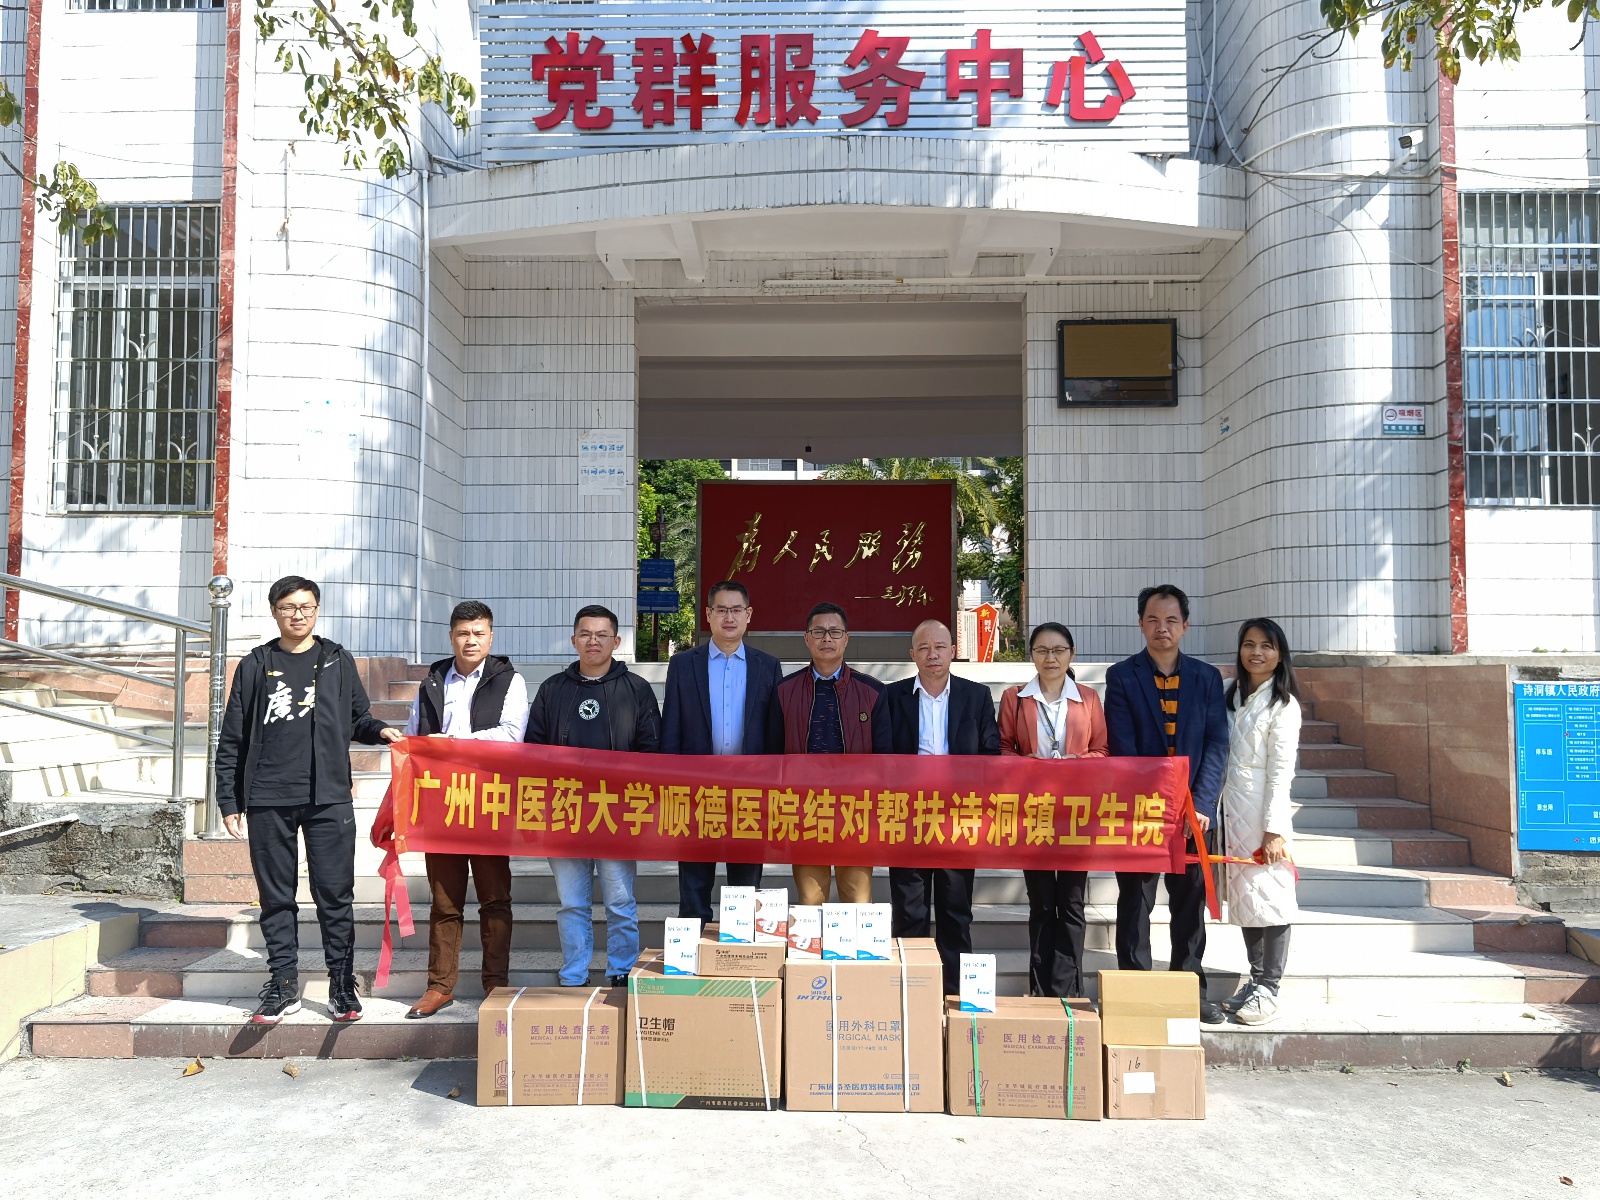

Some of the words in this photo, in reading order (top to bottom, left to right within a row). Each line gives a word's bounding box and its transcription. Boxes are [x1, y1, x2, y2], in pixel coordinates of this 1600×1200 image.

[531, 28, 1137, 131] 党群服务中心
[1523, 684, 1600, 697] 诗洞镇人民政府
[409, 768, 1167, 847] 广州中医药大学顺德医院结对帮扶诗洞镇卫生院
[530, 1025, 610, 1035] 医用检查手套
[638, 1016, 676, 1031] 卫生帽
[825, 1020, 901, 1032] 医用外科口罩
[826, 1033, 872, 1042] SRGICAL
[875, 1034, 901, 1042] MASK
[1003, 1033, 1085, 1046] 医用检查手套
[1128, 1056, 1141, 1071] 16
